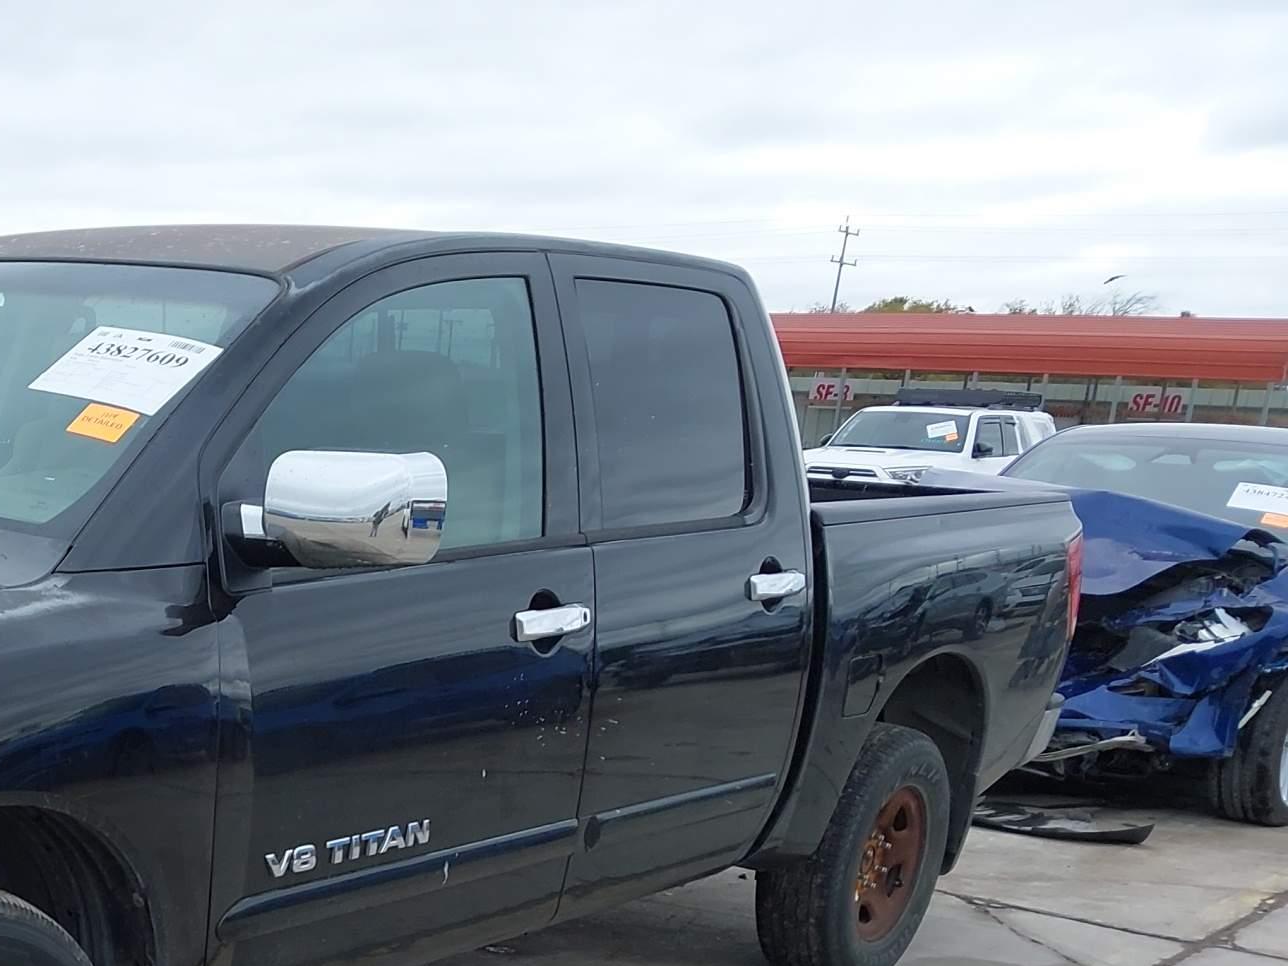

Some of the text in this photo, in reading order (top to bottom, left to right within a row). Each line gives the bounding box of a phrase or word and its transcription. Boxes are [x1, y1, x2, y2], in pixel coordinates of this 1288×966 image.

[87, 342, 190, 369] 43827609
[265, 818, 431, 878] V8 TITAN
